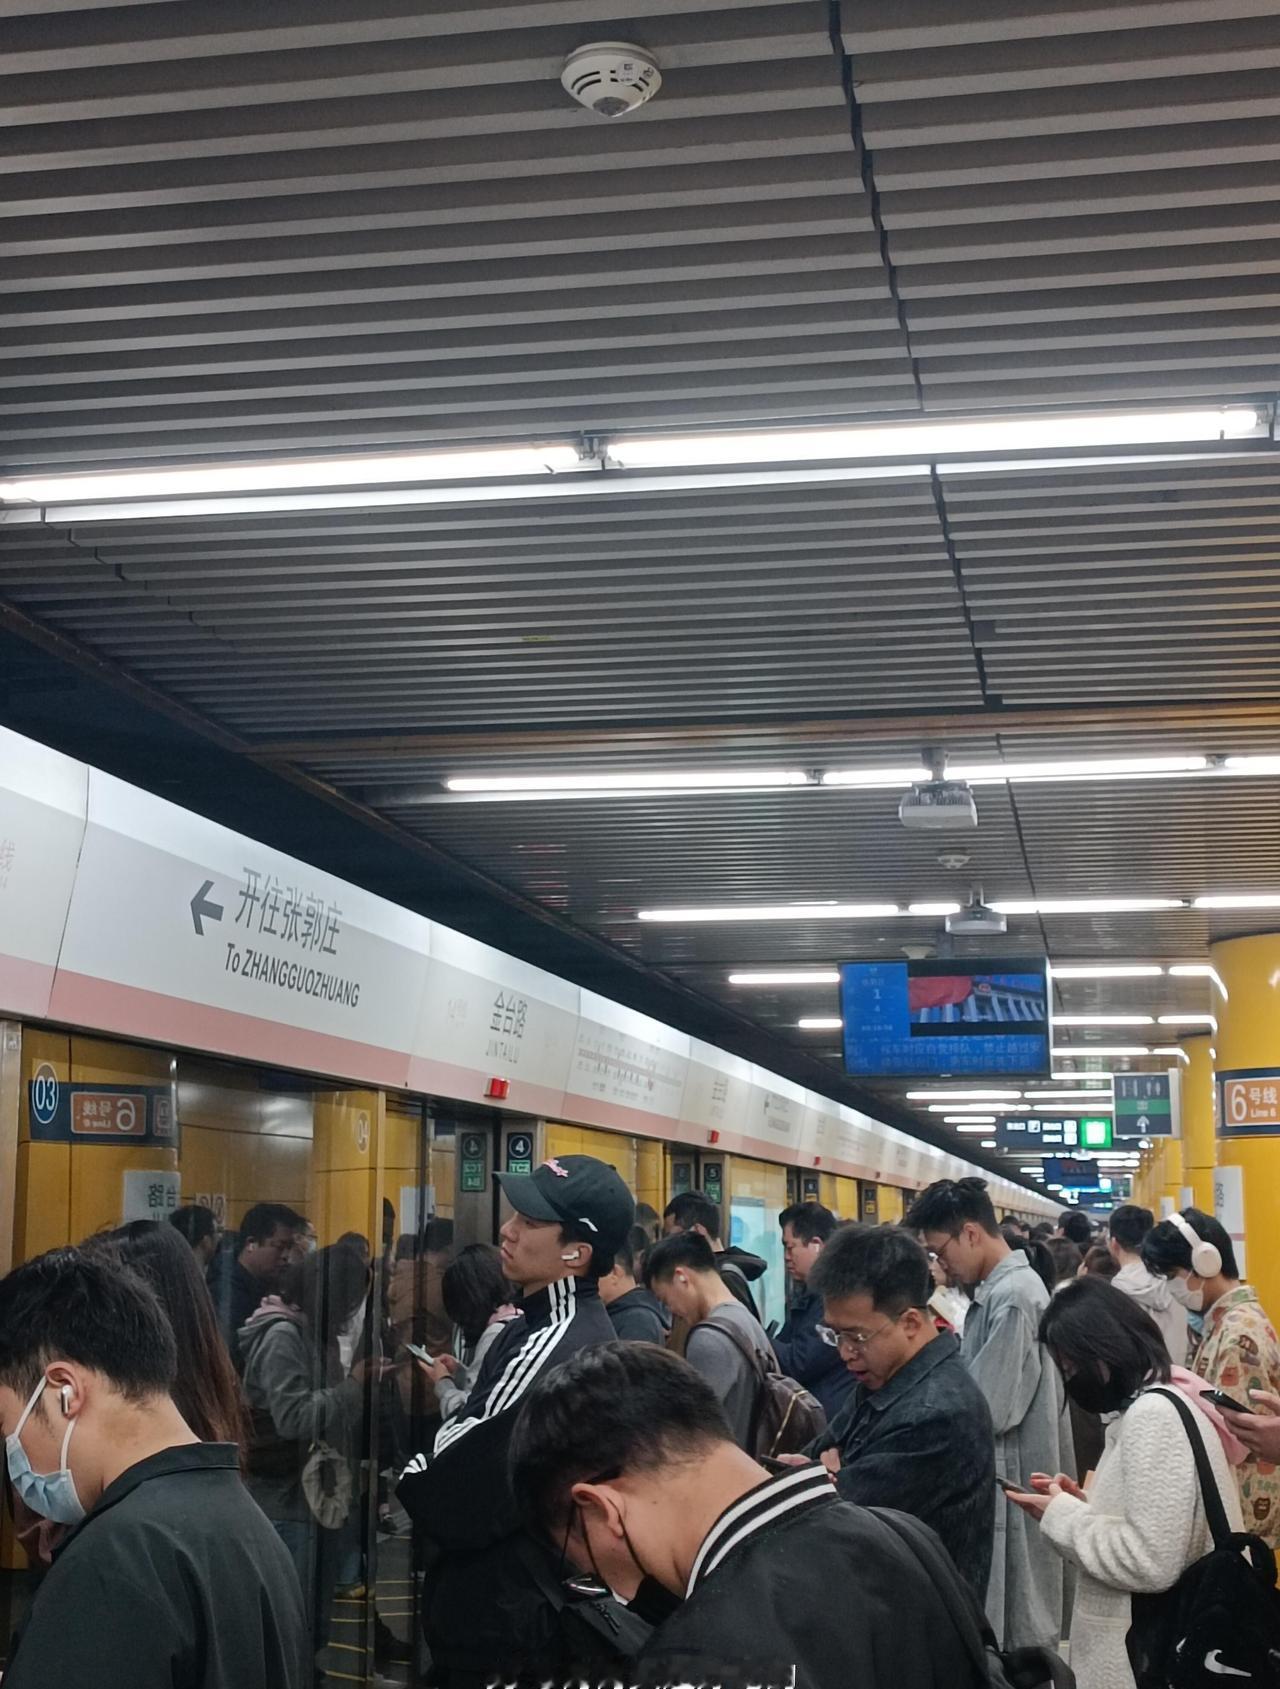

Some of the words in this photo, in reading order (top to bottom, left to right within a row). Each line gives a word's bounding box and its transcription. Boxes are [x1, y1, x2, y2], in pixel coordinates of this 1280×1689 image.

[235, 866, 343, 955] 开往张郭庄
[225, 942, 241, 973] To
[241, 949, 361, 1008] ZHANGGUOZHUANG
[490, 991, 528, 1039] 金台路
[35, 1075, 56, 1111] 03
[1231, 1084, 1248, 1121] 6
[1249, 1086, 1278, 1105] 号线
[1251, 1108, 1269, 1118] Line
[515, 1139, 525, 1153] 4
